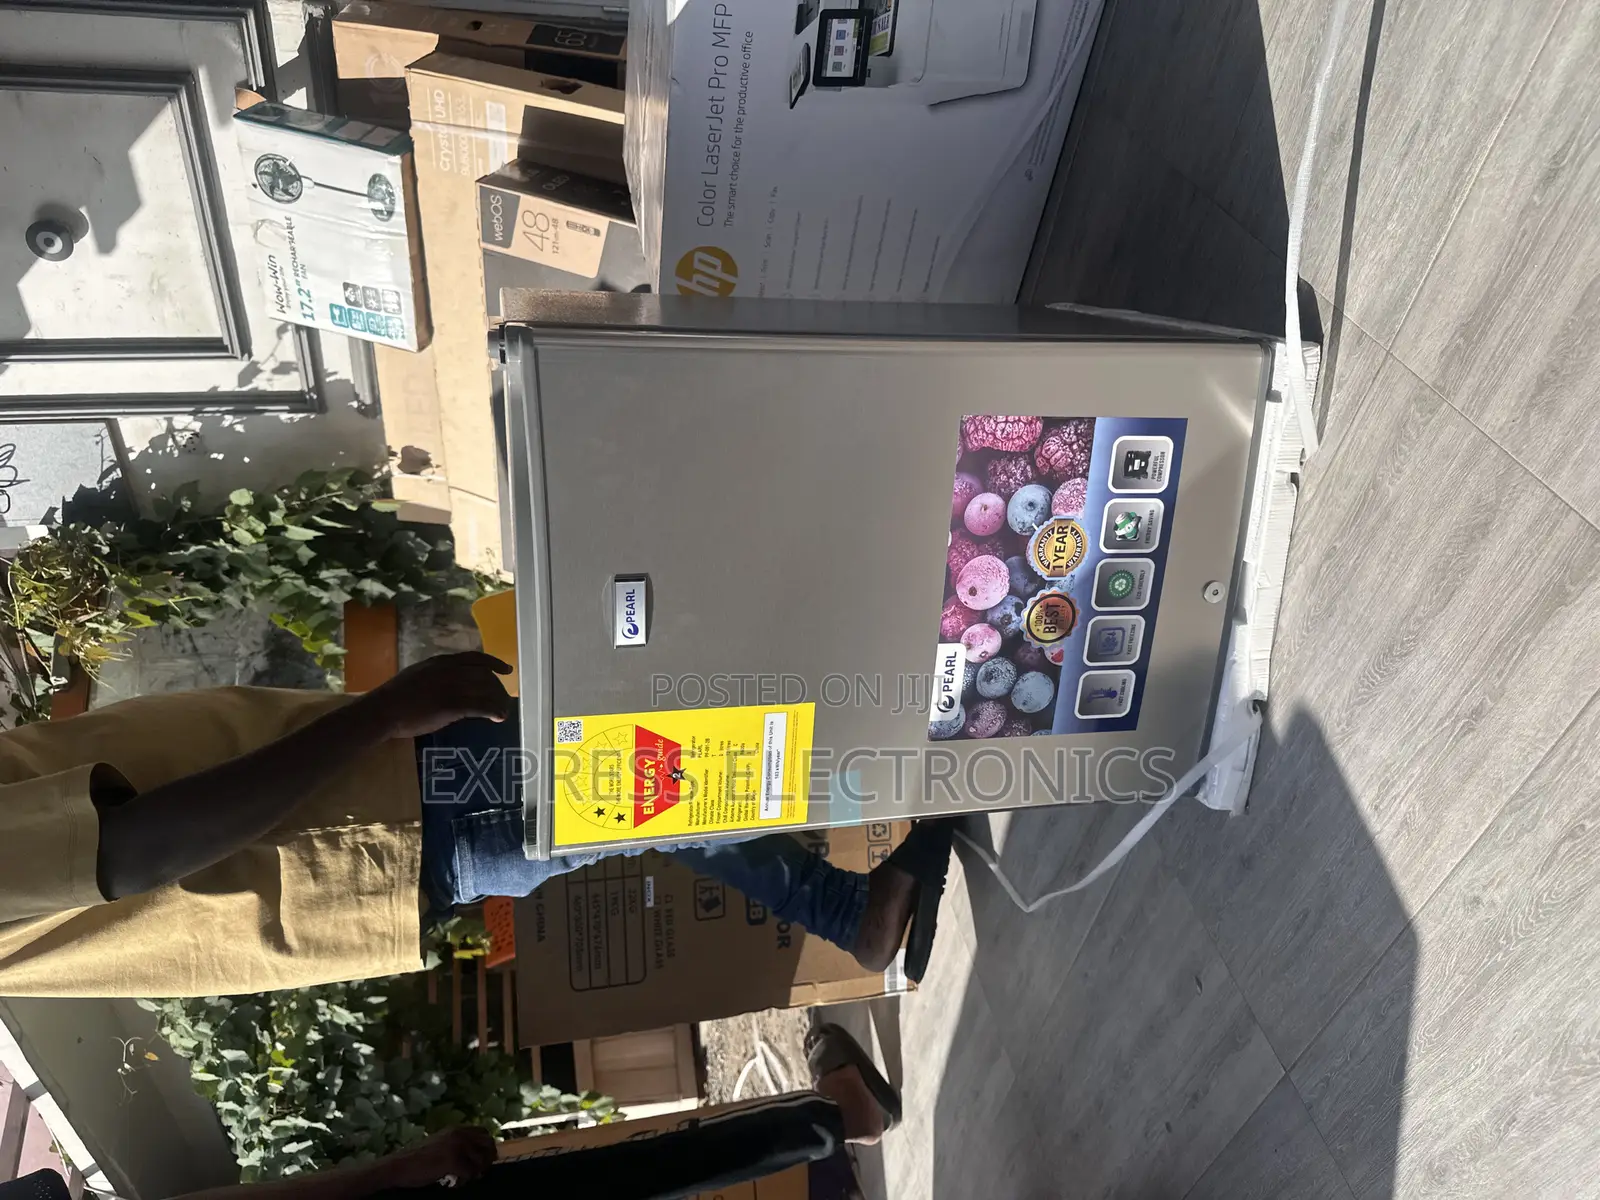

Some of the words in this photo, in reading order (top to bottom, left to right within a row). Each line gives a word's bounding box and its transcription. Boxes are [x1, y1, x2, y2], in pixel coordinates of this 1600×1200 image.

[554, 30, 588, 46] 65
[711, 3, 733, 49] MFP
[741, 31, 754, 60] office
[707, 55, 729, 89] Pro
[737, 62, 751, 115] productive
[434, 89, 446, 118] UHD
[701, 96, 725, 175] LaserJet
[733, 117, 745, 133] the
[731, 136, 742, 149] for
[729, 151, 741, 181] choice
[696, 180, 717, 227] Color
[727, 183, 737, 210] smart
[490, 194, 504, 241] webOS
[521, 209, 550, 252] 48
[723, 211, 734, 227] The
[267, 254, 287, 314] Wow-Win
[675, 250, 738, 297] hp
[1151, 455, 1159, 480] POWERFUL
[1156, 451, 1166, 482] COMPRESSOR
[1147, 509, 1155, 526] SAVING
[1038, 530, 1053, 567] WARRANTY
[1053, 525, 1069, 563] YEAR
[1066, 529, 1082, 567] WARRANTY
[1144, 526, 1152, 544] ENERGY
[625, 588, 635, 623] PEARL
[1034, 608, 1044, 628] 100%
[1043, 602, 1060, 634] BEST
[942, 651, 957, 693] PEARL
[655, 738, 666, 761] guide
[641, 758, 659, 815] ENERGY
[535, 903, 547, 943] CHINA
